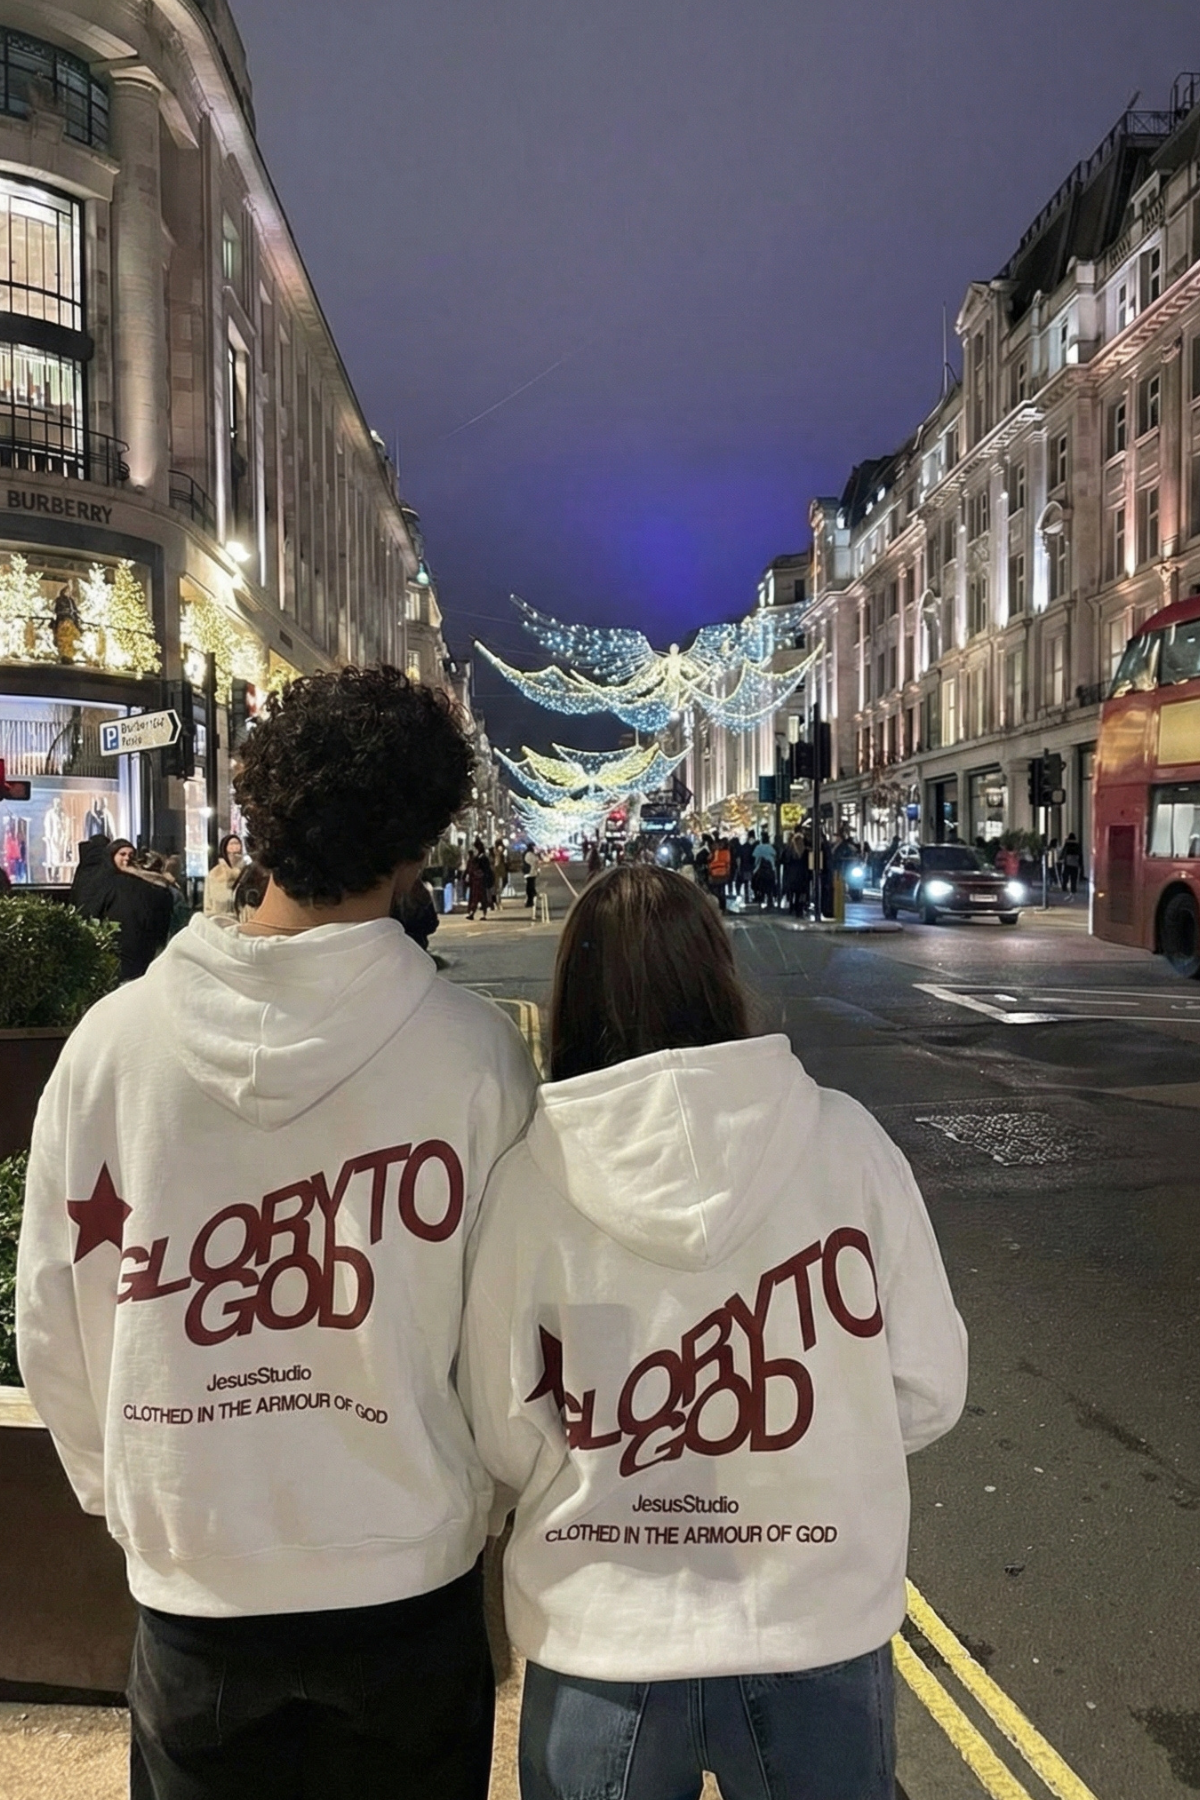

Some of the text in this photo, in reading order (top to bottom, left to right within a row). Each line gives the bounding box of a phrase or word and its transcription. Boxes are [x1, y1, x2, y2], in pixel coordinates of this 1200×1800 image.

[7, 490, 113, 525] BURBERRY
[185, 1245, 375, 1347] GOD
[206, 1364, 312, 1392] JesusStudio
[123, 1392, 388, 1425] CLOTHED IN THE ARMOUR OF GOD
[619, 1357, 815, 1478] GOD
[632, 1494, 740, 1514] JesusStudio
[545, 1524, 838, 1545] CLOTHED IN THE ARMOUR OF GOD
